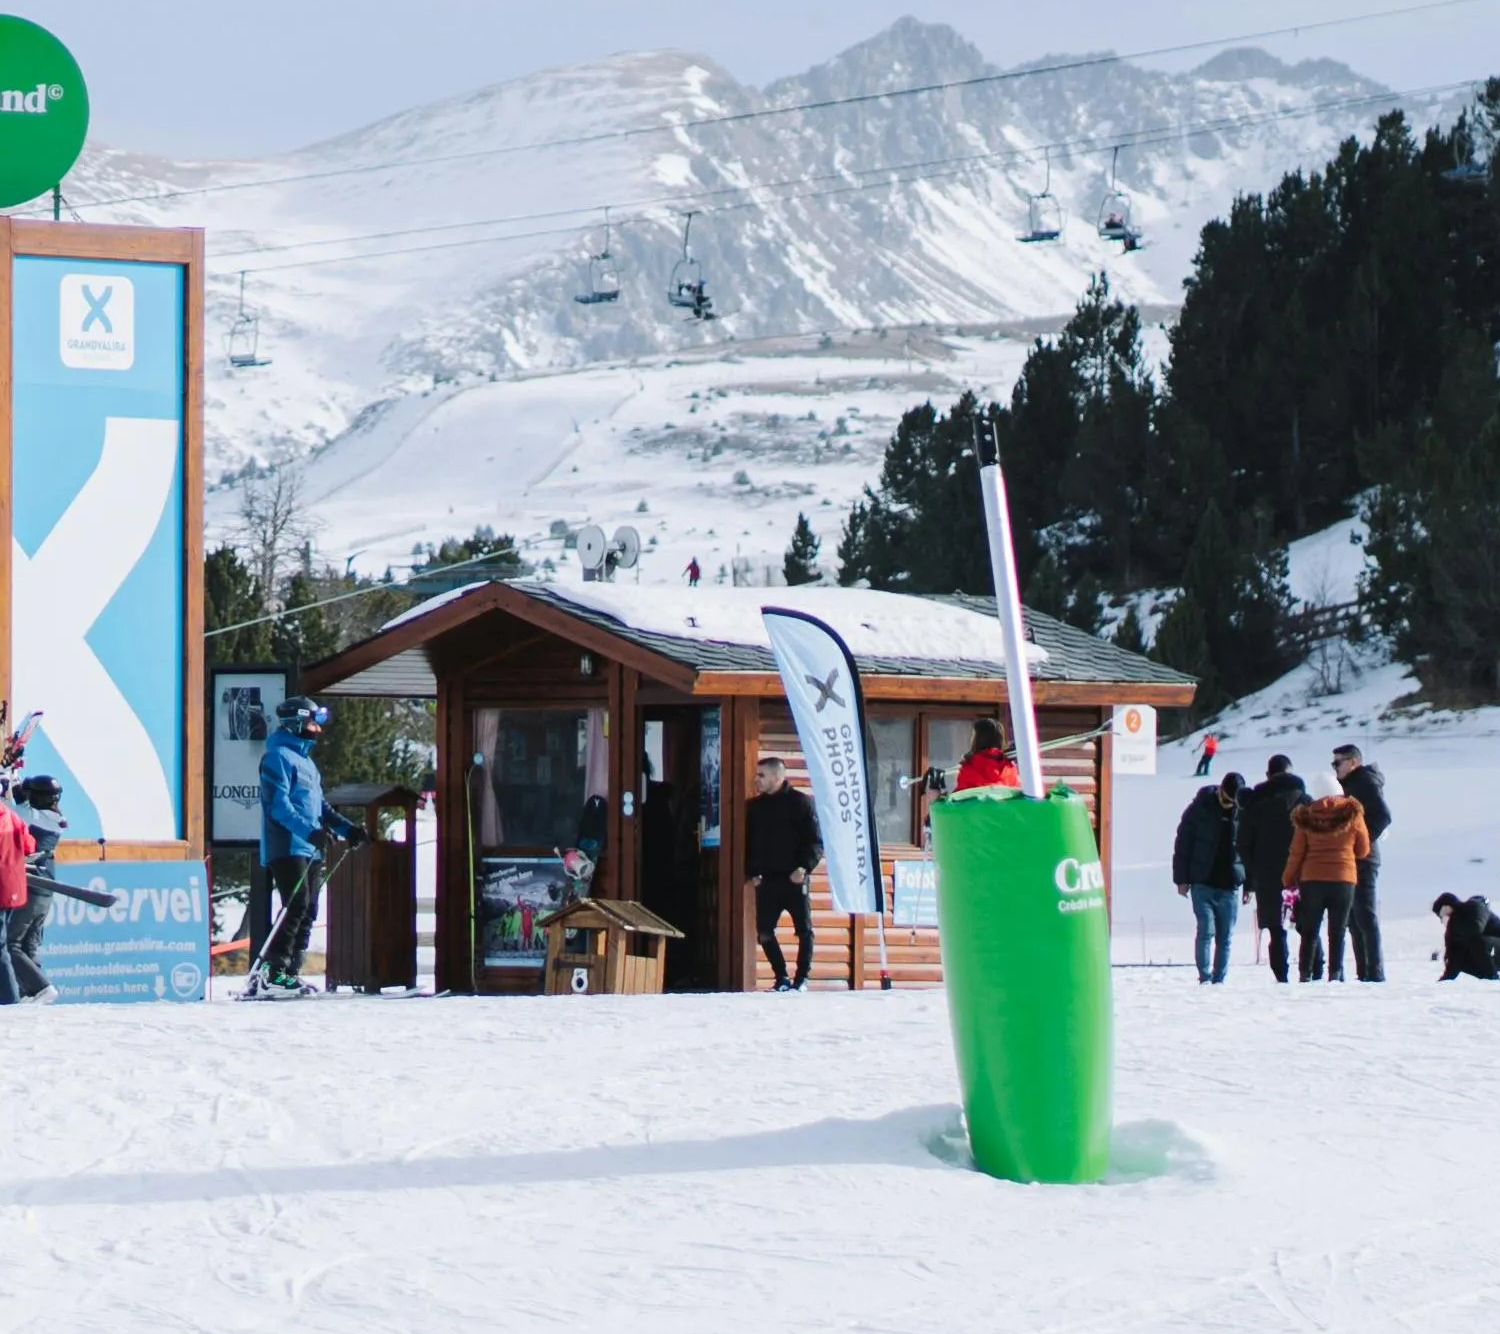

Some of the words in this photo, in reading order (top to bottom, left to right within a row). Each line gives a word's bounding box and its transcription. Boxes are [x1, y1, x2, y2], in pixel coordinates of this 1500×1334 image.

[822, 727, 851, 823] PHOTOS
[839, 723, 868, 887] GRANDVALIRA
[57, 983, 81, 996] Your
[84, 981, 120, 995] photos
[123, 982, 149, 992] here
